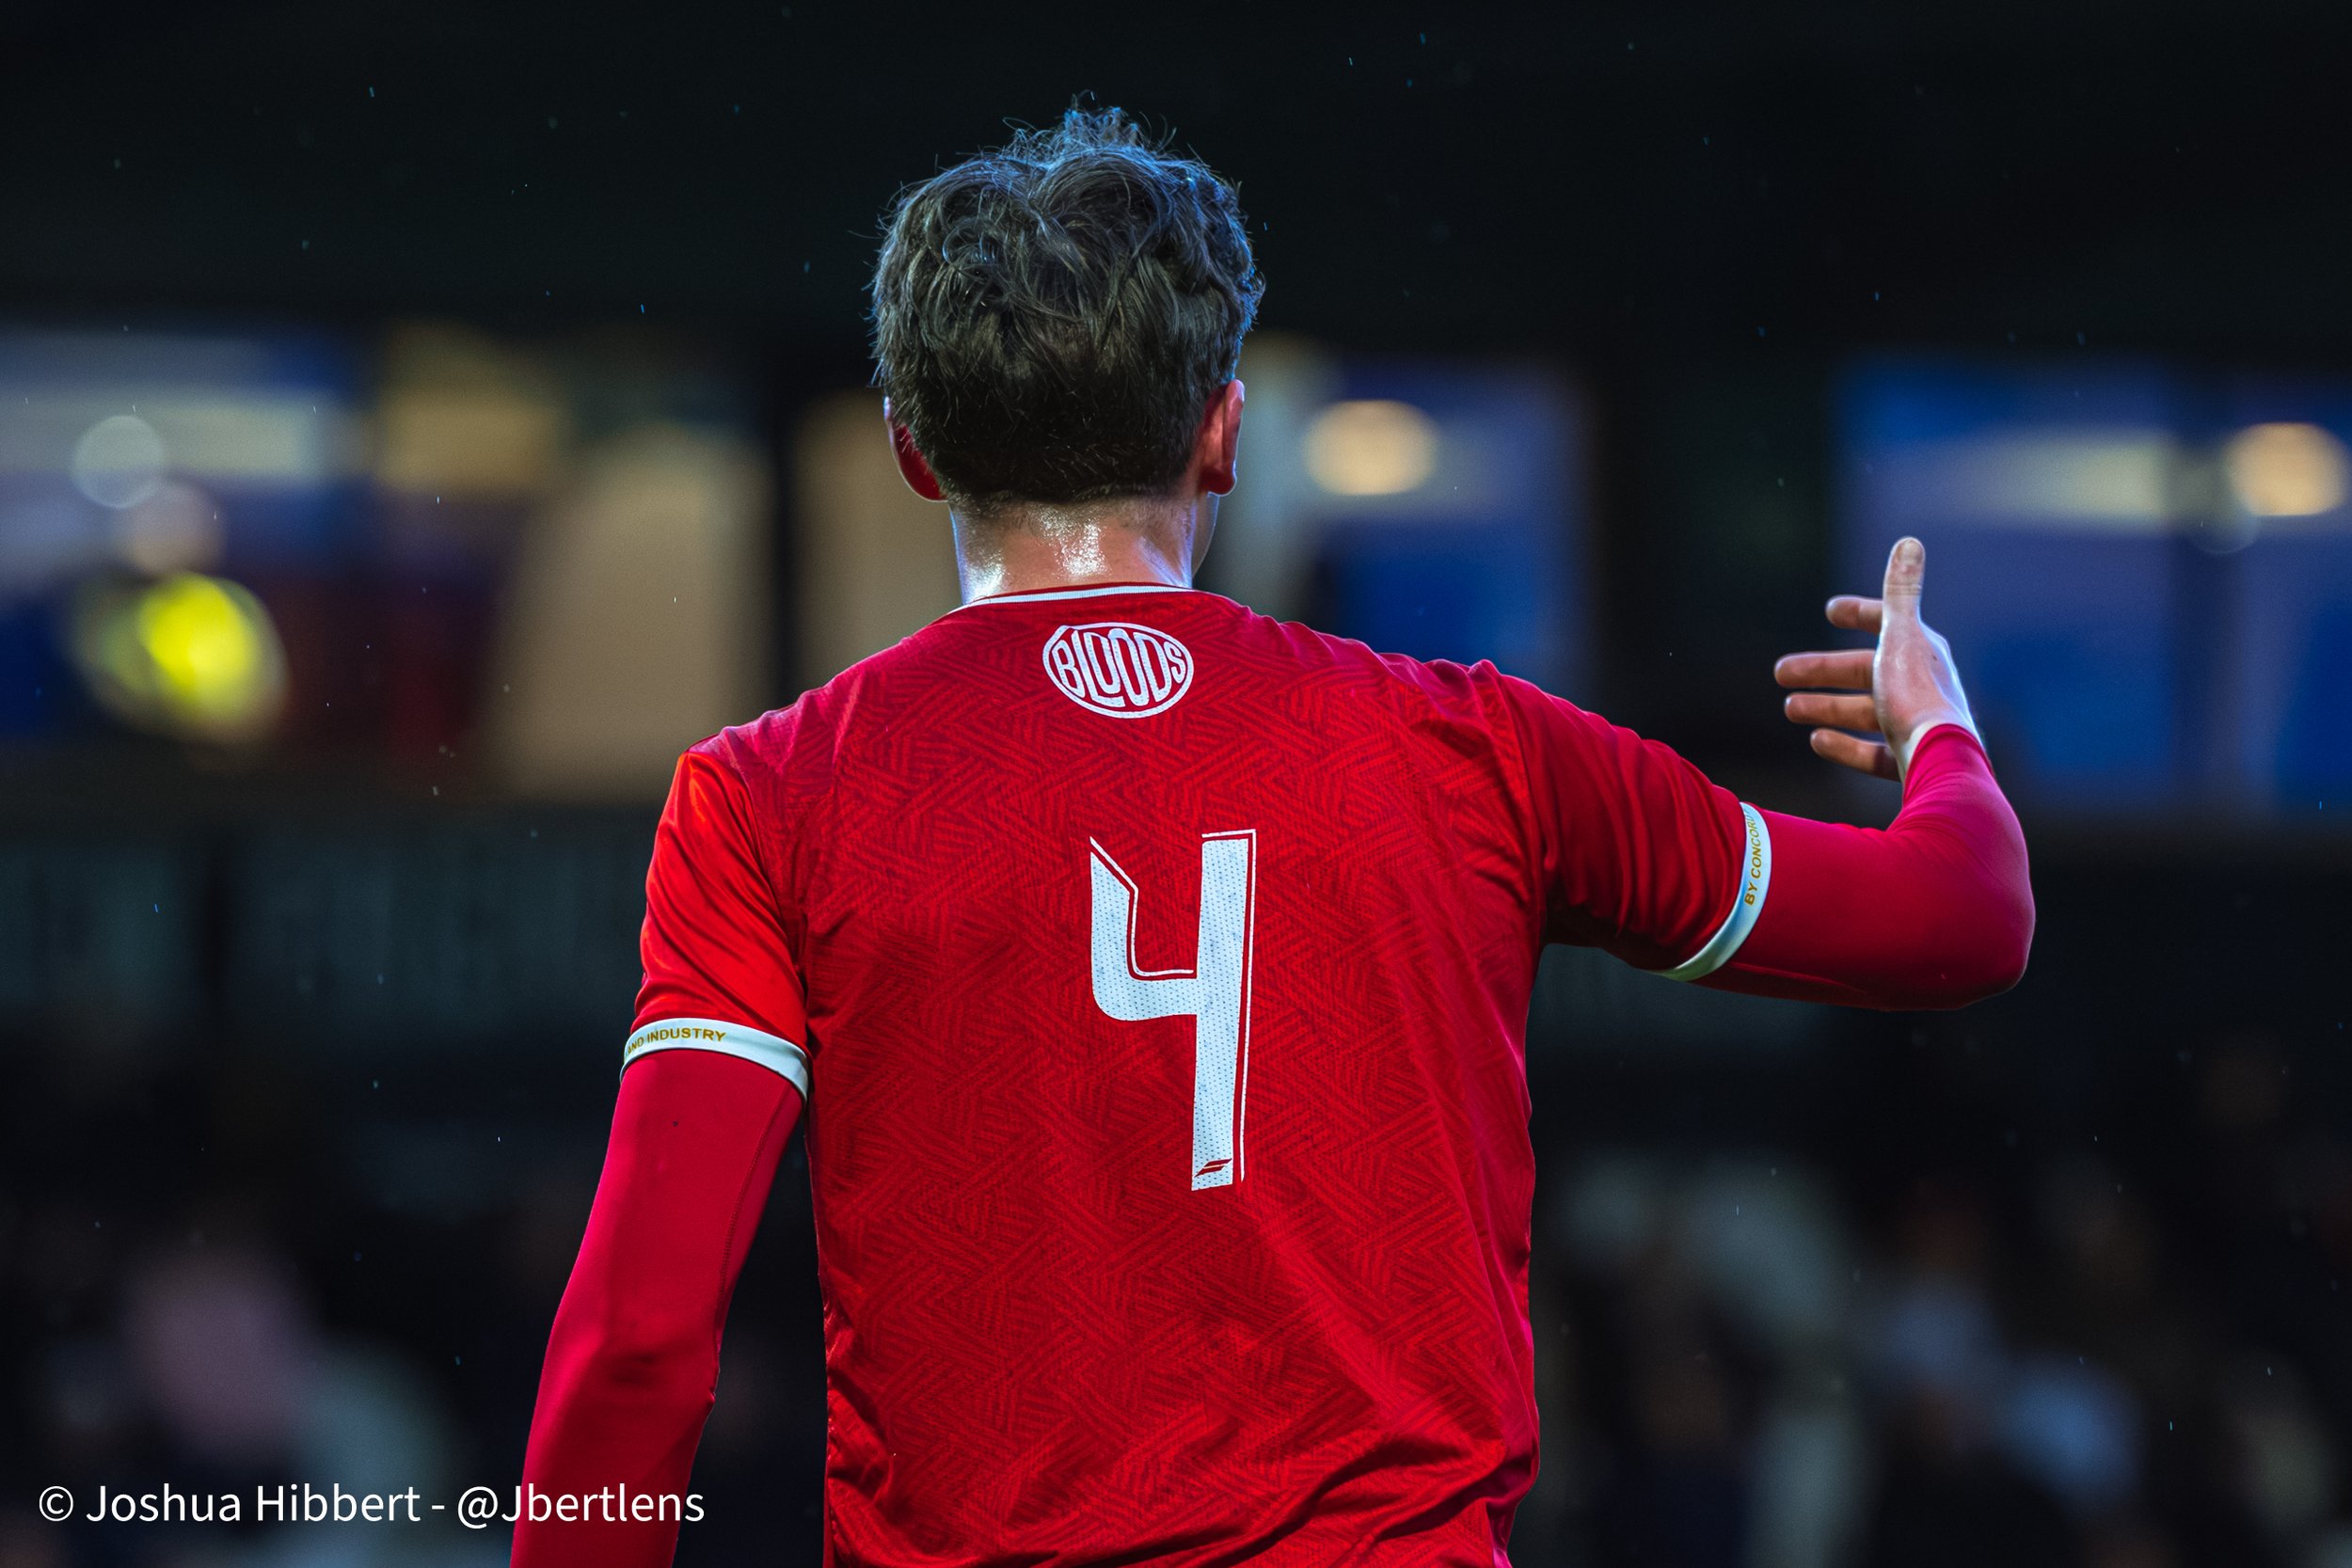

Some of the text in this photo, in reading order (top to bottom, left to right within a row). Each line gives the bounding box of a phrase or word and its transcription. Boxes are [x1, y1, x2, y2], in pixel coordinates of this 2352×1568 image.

[1051, 627, 1186, 707] BLOODS
[1744, 881, 1758, 906] BY
[1089, 829, 1256, 1192] 4
[628, 1027, 727, 1053] AND INDUSTRY
